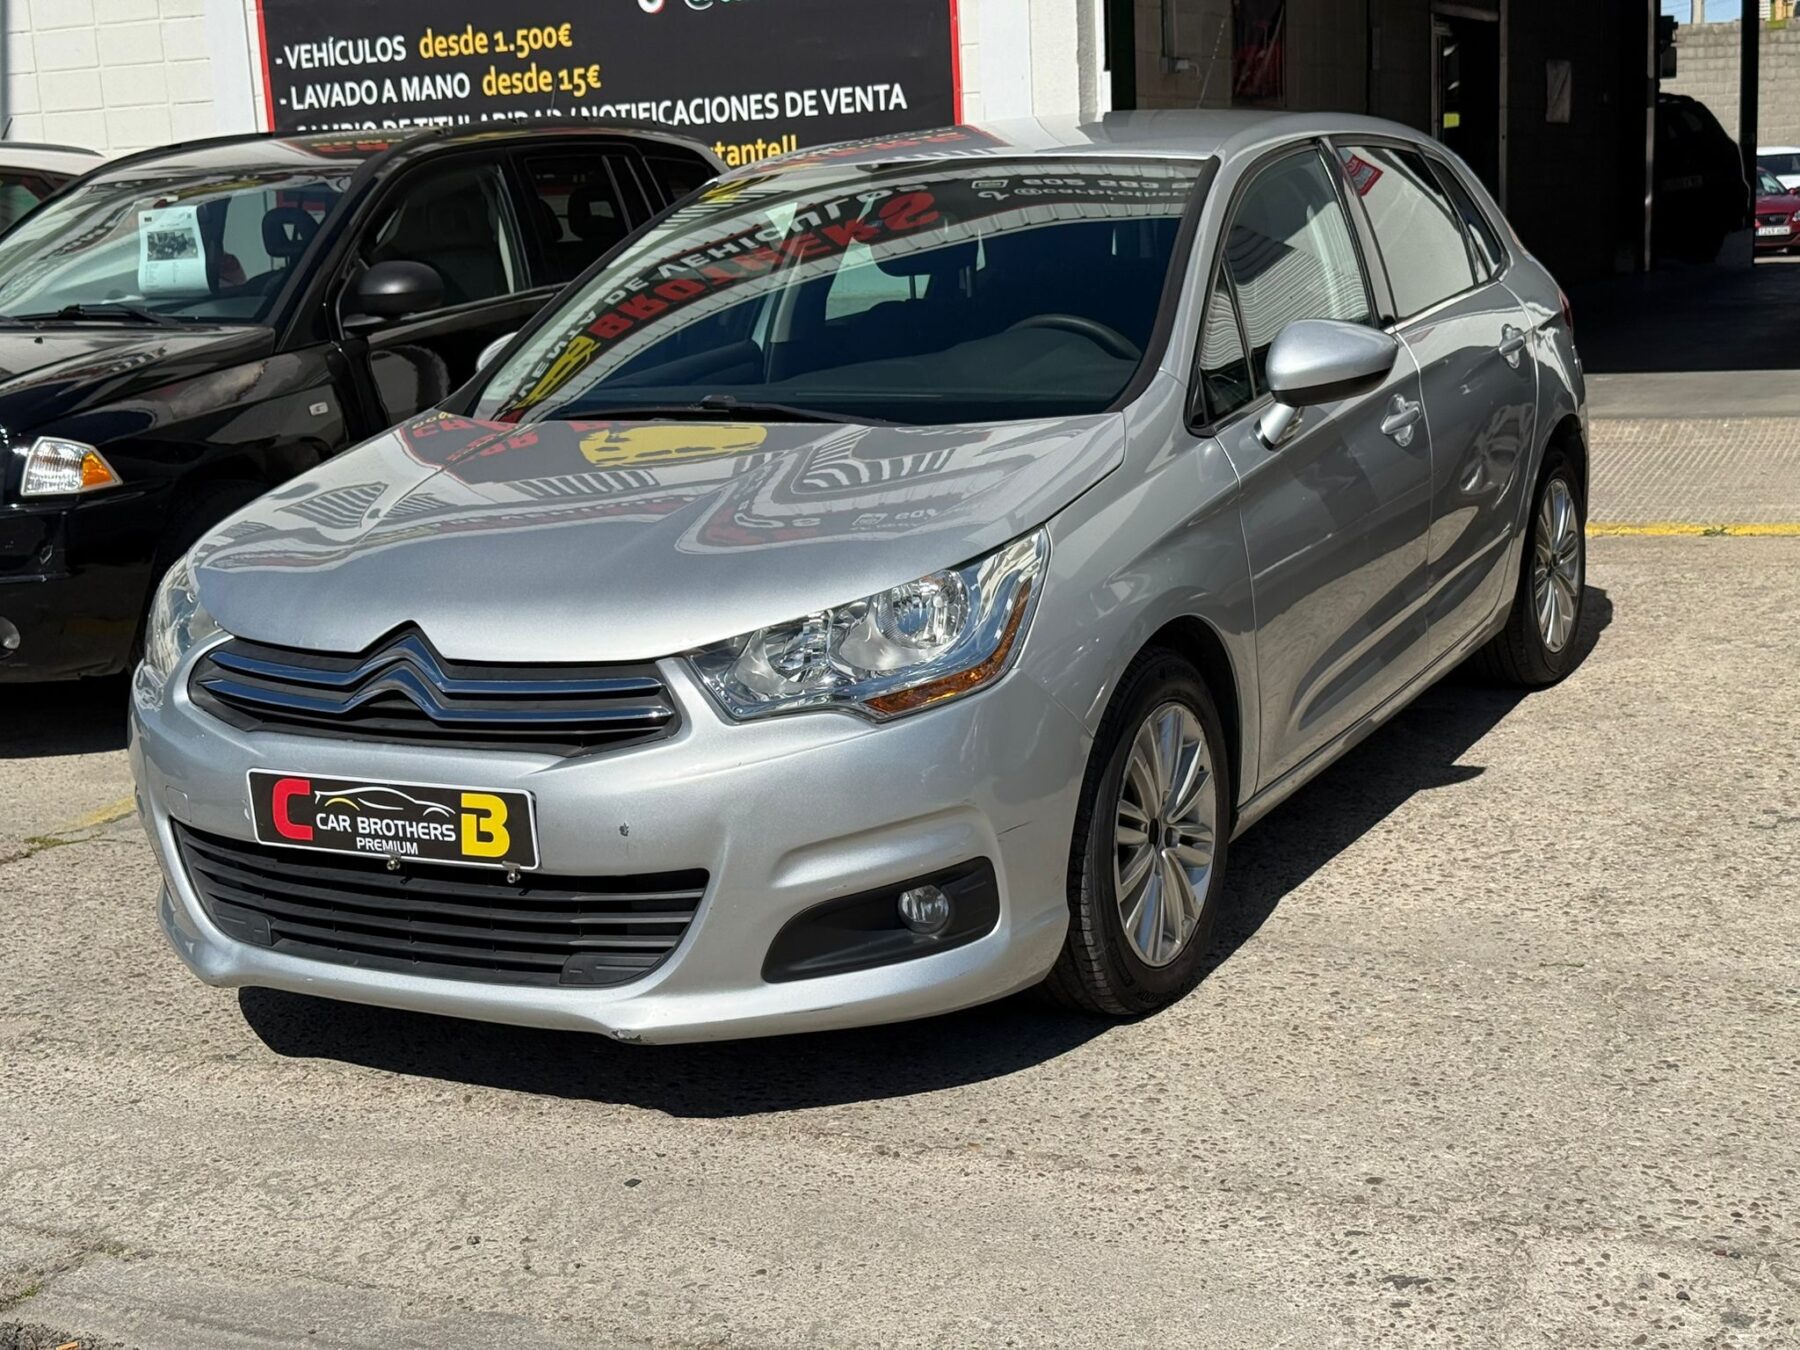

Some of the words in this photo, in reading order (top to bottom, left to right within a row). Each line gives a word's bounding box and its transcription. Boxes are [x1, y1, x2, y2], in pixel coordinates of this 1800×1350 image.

[284, 36, 406, 70] VEHÍCULOS
[420, 25, 489, 59] desde
[494, 23, 573, 59] 1.500€
[290, 79, 379, 110] LAVADO
[382, 78, 398, 103] A
[400, 72, 471, 102] MANO
[482, 62, 553, 97] desde
[558, 64, 602, 98] 15€
[784, 90, 819, 118] DE
[821, 83, 908, 115] VENTA
[315, 813, 352, 833] CAR
[356, 816, 457, 842] BROTHERS
[356, 837, 419, 855] PREMIUM
